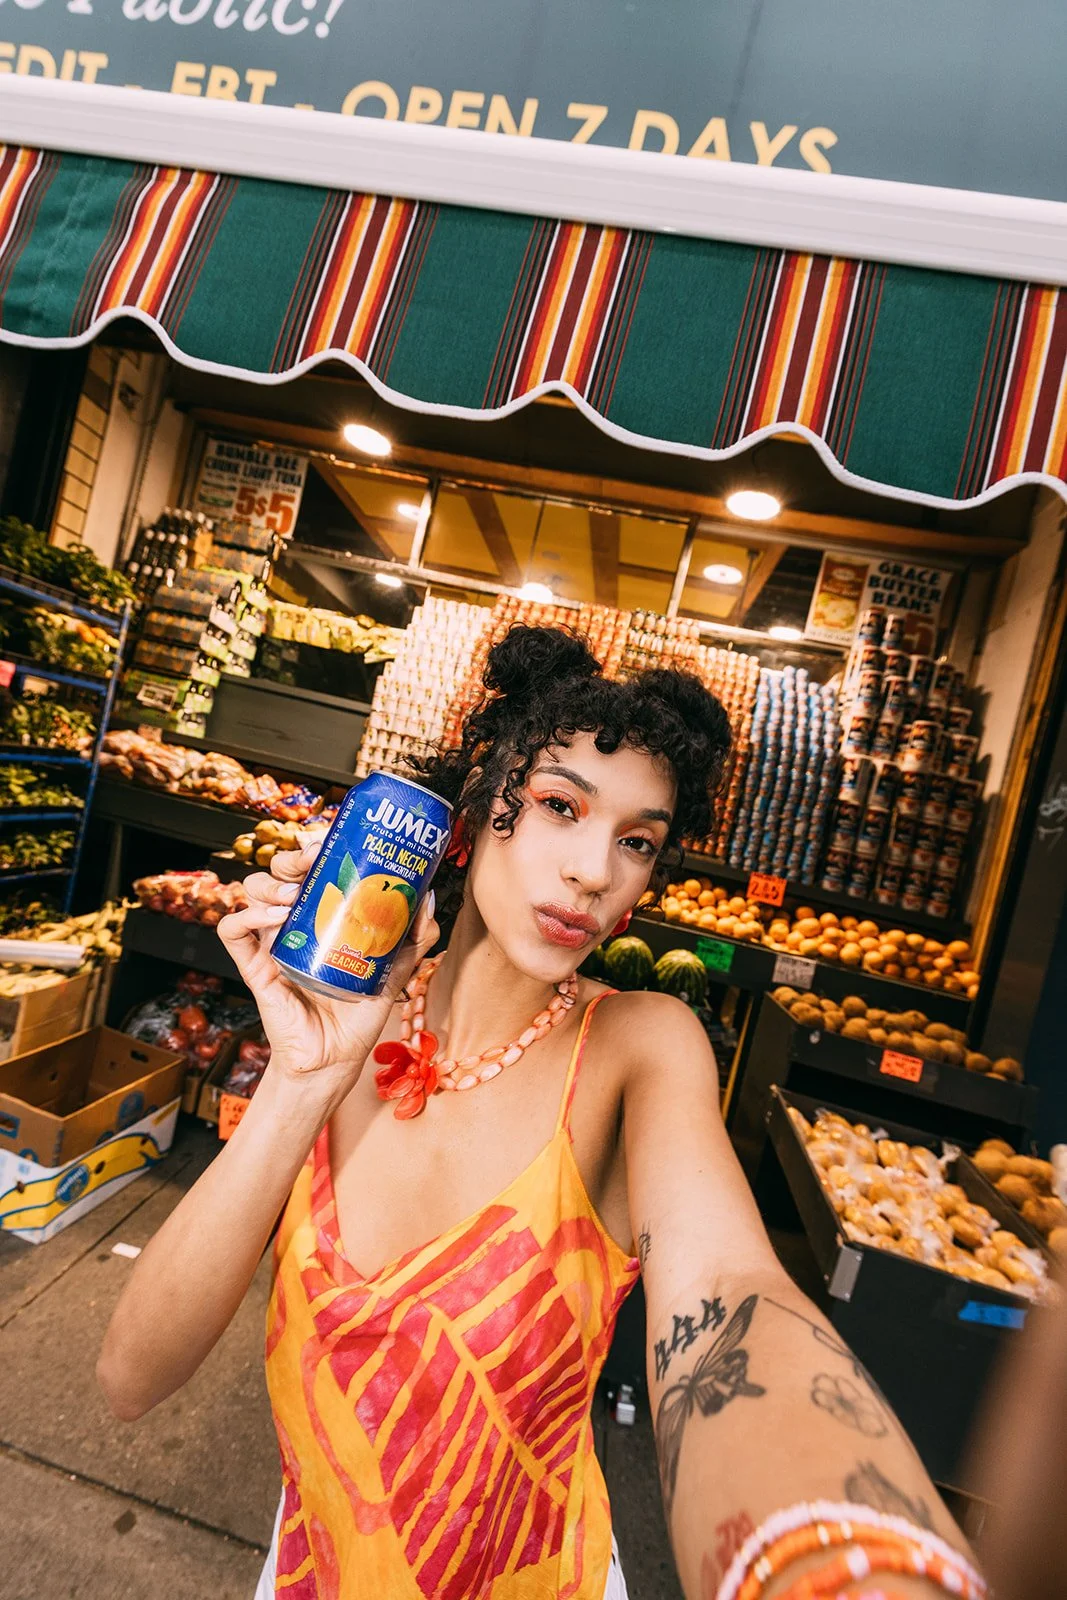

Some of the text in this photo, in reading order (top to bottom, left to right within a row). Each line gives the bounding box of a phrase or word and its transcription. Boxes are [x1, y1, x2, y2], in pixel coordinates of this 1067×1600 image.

[628, 109, 839, 174] DAYS
[366, 797, 449, 855] JUMEX
[372, 824, 394, 839] Fruta
[394, 835, 406, 845] de
[406, 840, 418, 850] mi
[362, 833, 429, 876] PEACH NECTAR
[367, 851, 417, 881] FROM CONCENTRATE
[305, 877, 317, 895] CASH
[312, 855, 328, 879] REFUND
[325, 951, 367, 975] PEACHES
